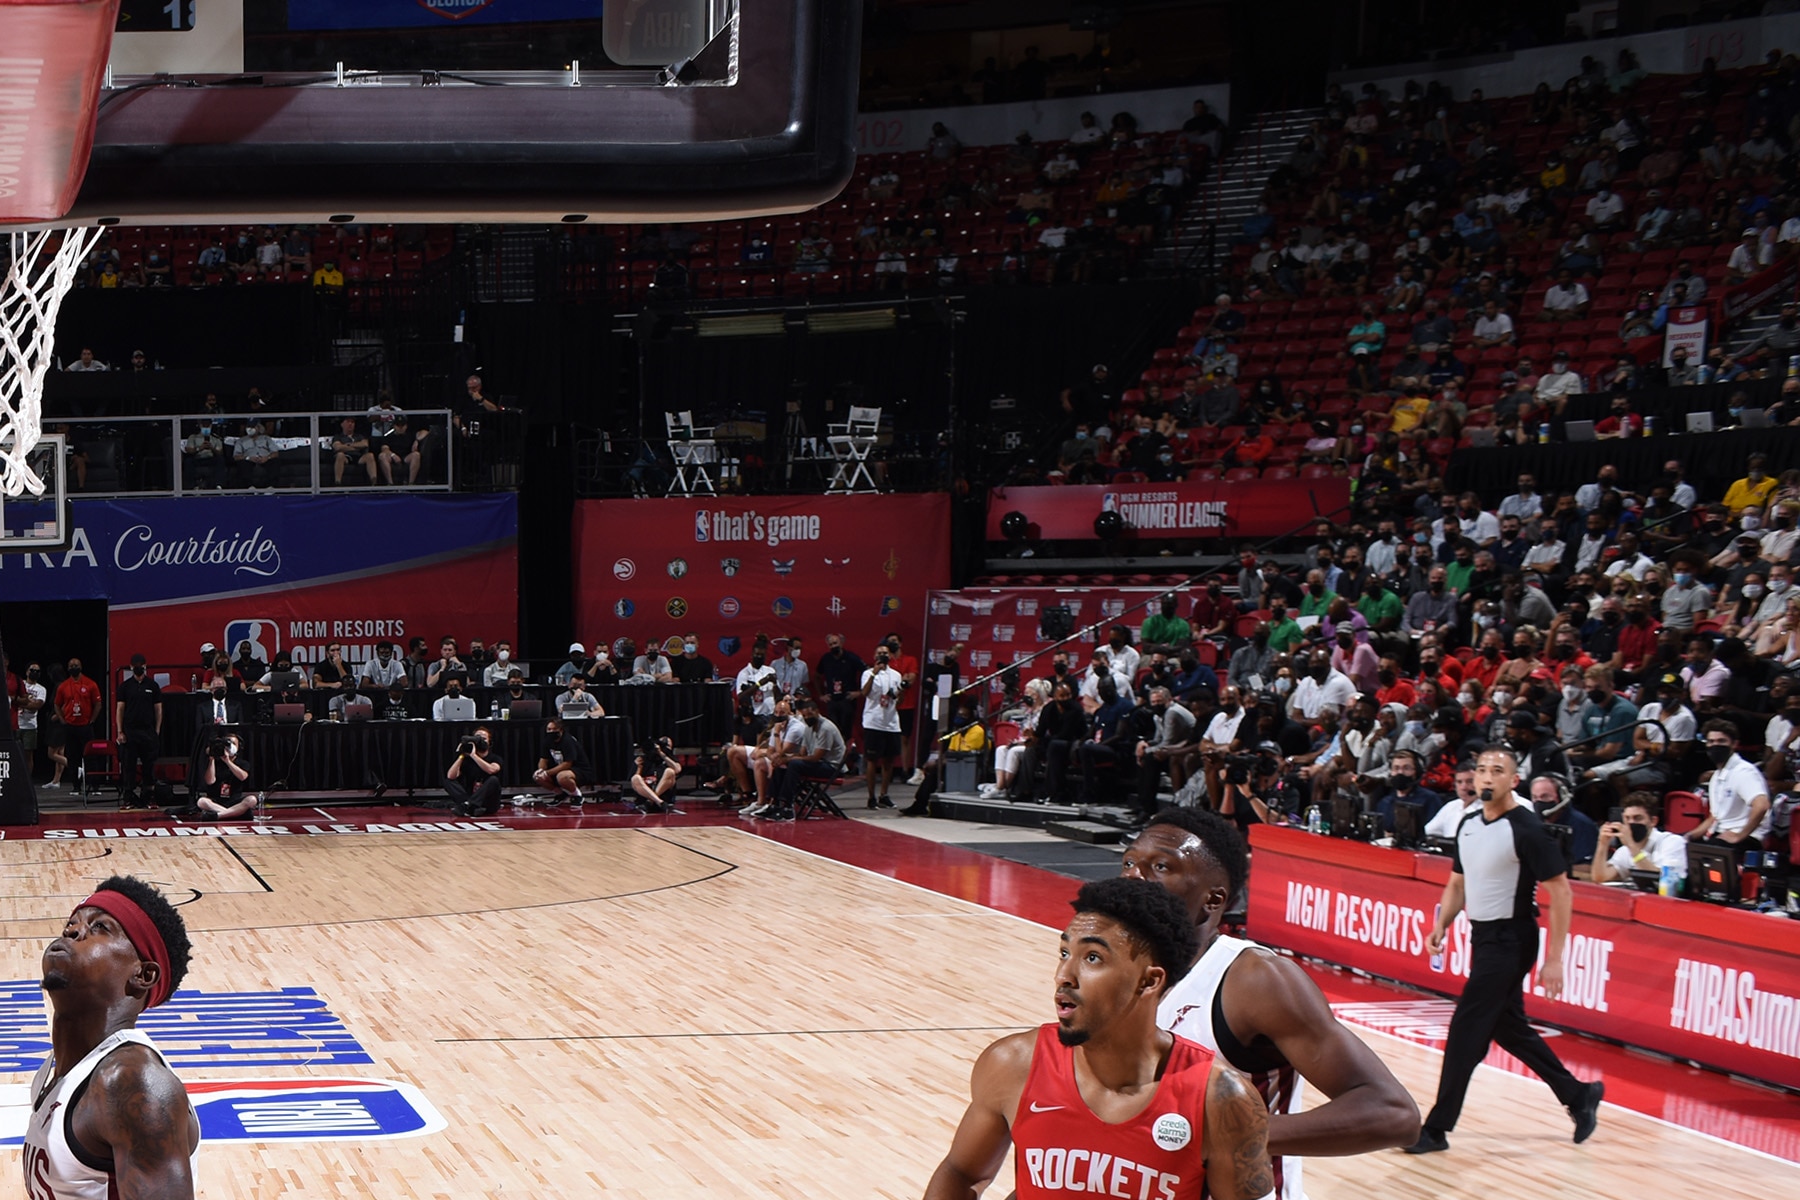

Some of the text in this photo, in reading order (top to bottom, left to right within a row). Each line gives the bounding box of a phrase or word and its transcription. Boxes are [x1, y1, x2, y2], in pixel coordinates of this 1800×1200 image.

[856, 117, 904, 148] 102
[1141, 491, 1178, 502] RESORTS
[1119, 502, 1178, 529] SUMMER
[767, 511, 820, 546] game
[113, 522, 281, 576] Courtside
[289, 618, 405, 639] MGM RESORTS
[42, 825, 295, 840] SUMMER
[303, 821, 515, 835] LEAGUE
[1285, 881, 1328, 932] MGM
[1333, 891, 1426, 957] RESORTS
[231, 1098, 383, 1134] NBA
[1160, 1118, 1187, 1130] credit
[1157, 1126, 1187, 1138] karma
[1157, 1134, 1185, 1145] MONEY
